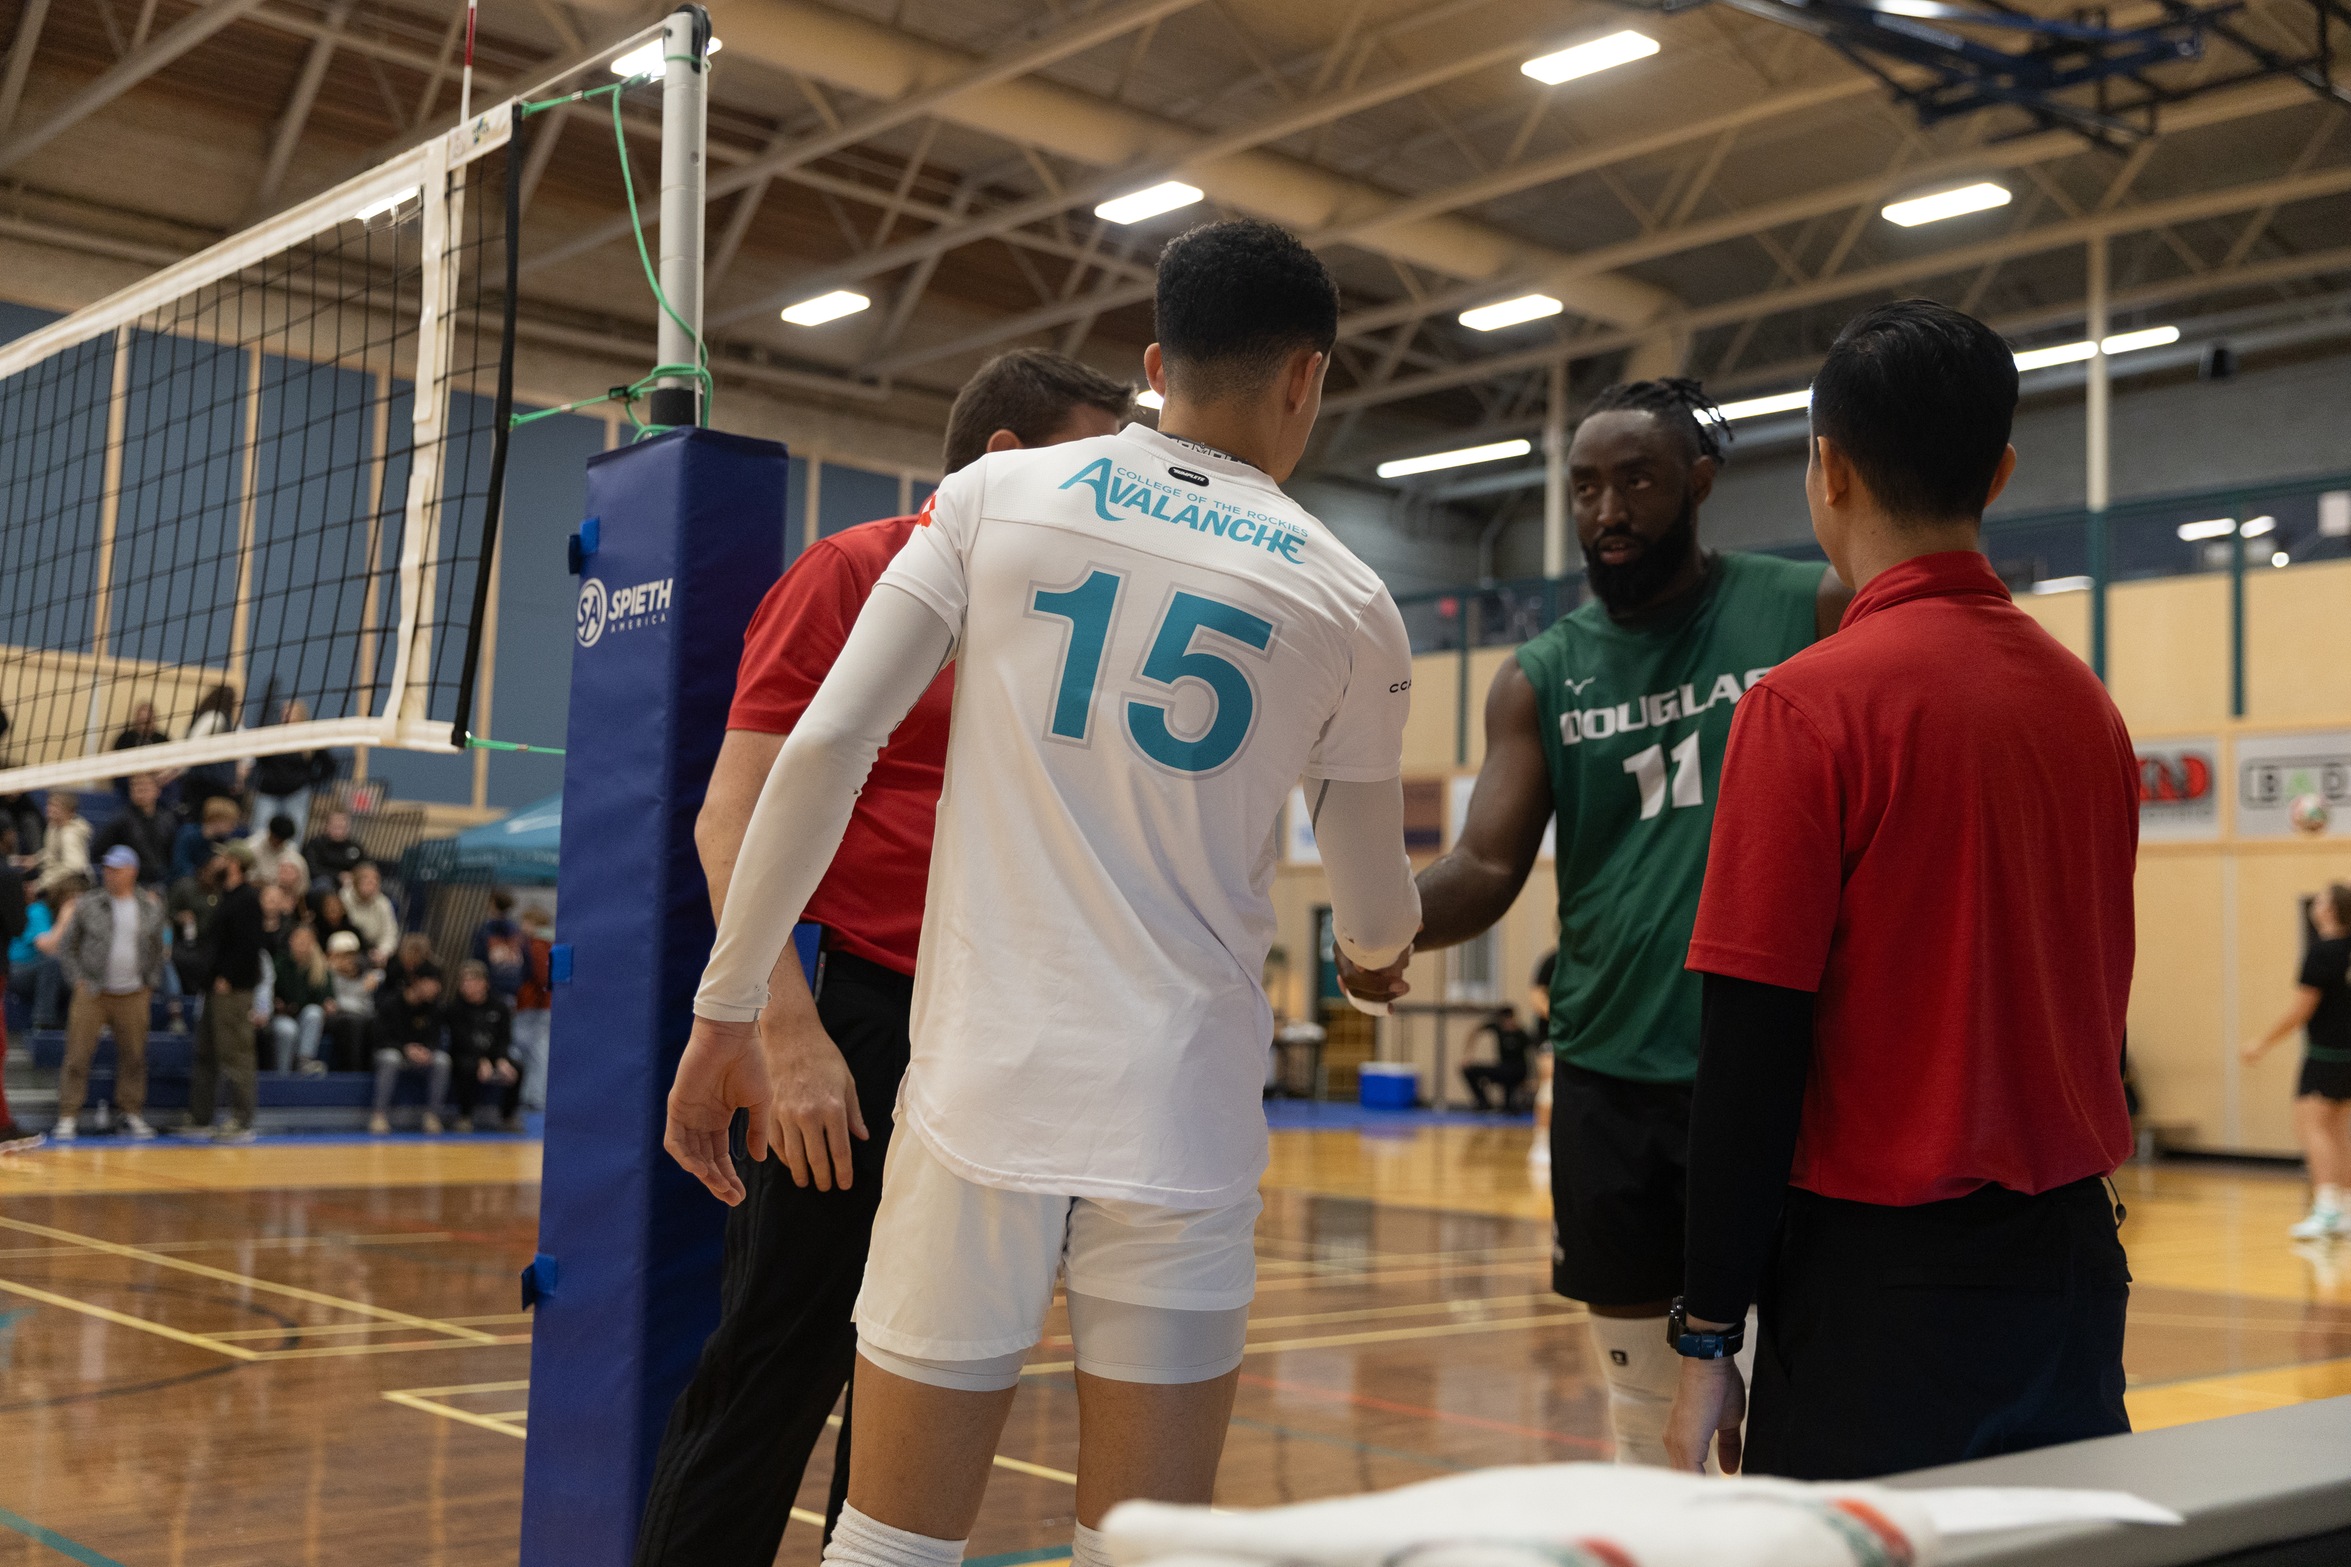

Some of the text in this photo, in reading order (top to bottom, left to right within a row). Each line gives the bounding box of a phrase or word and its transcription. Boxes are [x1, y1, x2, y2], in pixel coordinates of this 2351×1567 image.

[1057, 457, 1306, 565] AVALANCHE
[1116, 466, 1309, 538] COLLEGE OF THE ROCKIES
[608, 577, 674, 621] SPIETH
[610, 612, 667, 634] AMERICA
[1025, 562, 1281, 778] 15
[1622, 729, 1704, 821] 11
